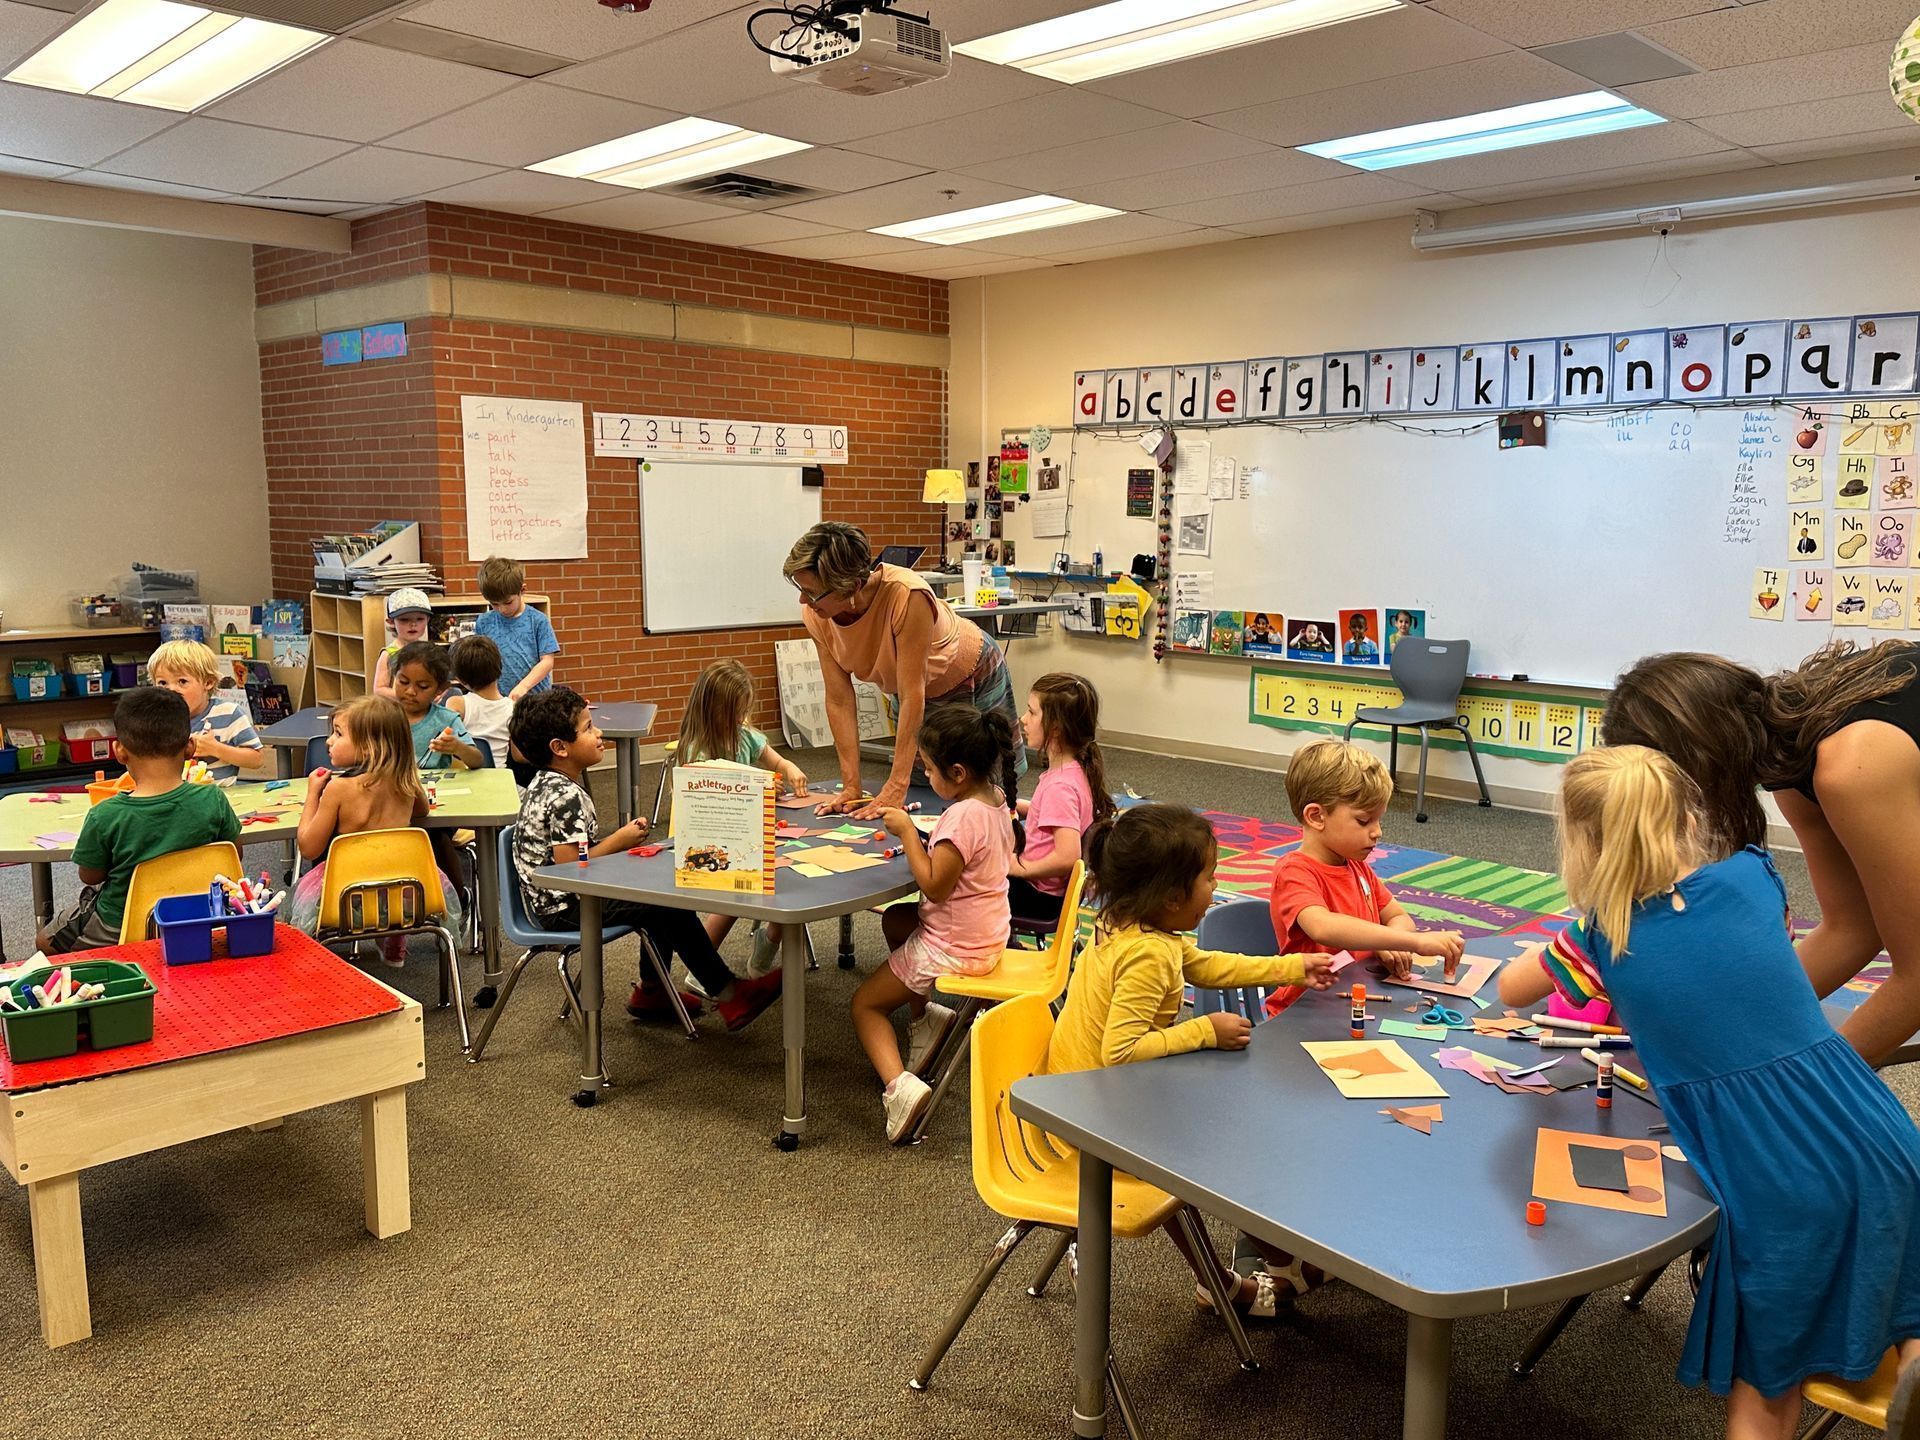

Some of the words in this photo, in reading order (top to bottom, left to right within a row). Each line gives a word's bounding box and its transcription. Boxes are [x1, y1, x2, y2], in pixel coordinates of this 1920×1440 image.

[1080, 392, 1096, 416] a
[1116, 379, 1130, 418] b
[1146, 392, 1162, 415] c
[1180, 377, 1196, 417] d
[1216, 389, 1236, 412] e
[1260, 367, 1276, 411] f
[1296, 377, 1313, 411] g
[1342, 362, 1360, 408] h
[1386, 364, 1392, 404] i
[1424, 364, 1441, 406] j
[1474, 357, 1493, 404] k
[1566, 365, 1604, 395] m
[1626, 360, 1652, 391] n
[1682, 362, 1712, 392] o
[1745, 353, 1771, 393] p
[1801, 345, 1839, 388] q
[1872, 351, 1901, 385] r
[476, 404, 494, 422] In
[506, 406, 575, 432] Kindergarten
[1802, 406, 1821, 420] Aa
[1852, 404, 1870, 419] Bb
[1889, 405, 1908, 419] Cc
[488, 430, 516, 449] paint
[600, 417, 604, 439] 1
[620, 419, 630, 440] 2
[646, 420, 658, 442] 3
[671, 421, 682, 442] 4
[700, 423, 710, 444] 5
[725, 425, 736, 446] 6
[752, 426, 761, 446] 7
[775, 427, 785, 447] 8
[804, 429, 813, 448] 9
[830, 429, 844, 449] 10
[1738, 434, 1764, 444] James
[488, 450, 516, 462] talk
[1739, 447, 1772, 463] Kaylin
[1737, 463, 1753, 471] Ella
[1792, 455, 1814, 472] Gg
[1847, 458, 1866, 473] Hh
[489, 466, 513, 479] play
[490, 478, 528, 488] recess
[1734, 484, 1758, 493] Millie
[488, 490, 518, 501] color
[1730, 494, 1767, 508] Sagan
[490, 504, 523, 515] math
[519, 514, 561, 531] pictures
[1793, 511, 1820, 525] Mm
[1842, 517, 1863, 531] Nn
[1880, 516, 1904, 531] Oo
[491, 529, 532, 542] letters
[1726, 525, 1751, 538] Ripley
[1763, 571, 1778, 585] Tt
[1805, 571, 1823, 585] Uu
[1843, 576, 1860, 590] Vv
[1876, 579, 1902, 593] Ww
[280, 612, 293, 624] SPY
[266, 697, 280, 709] SPY
[1266, 693, 1270, 710] 1
[1283, 695, 1296, 714] 2
[1308, 697, 1319, 716] 3
[1331, 700, 1342, 719] 4
[1481, 718, 1502, 738] 10
[1518, 720, 1530, 741] 11
[1553, 726, 1572, 747] 12
[688, 779, 732, 794] Rattletrap
[735, 784, 749, 792] Car
[1398, 890, 1516, 919] ALLIGATOR
